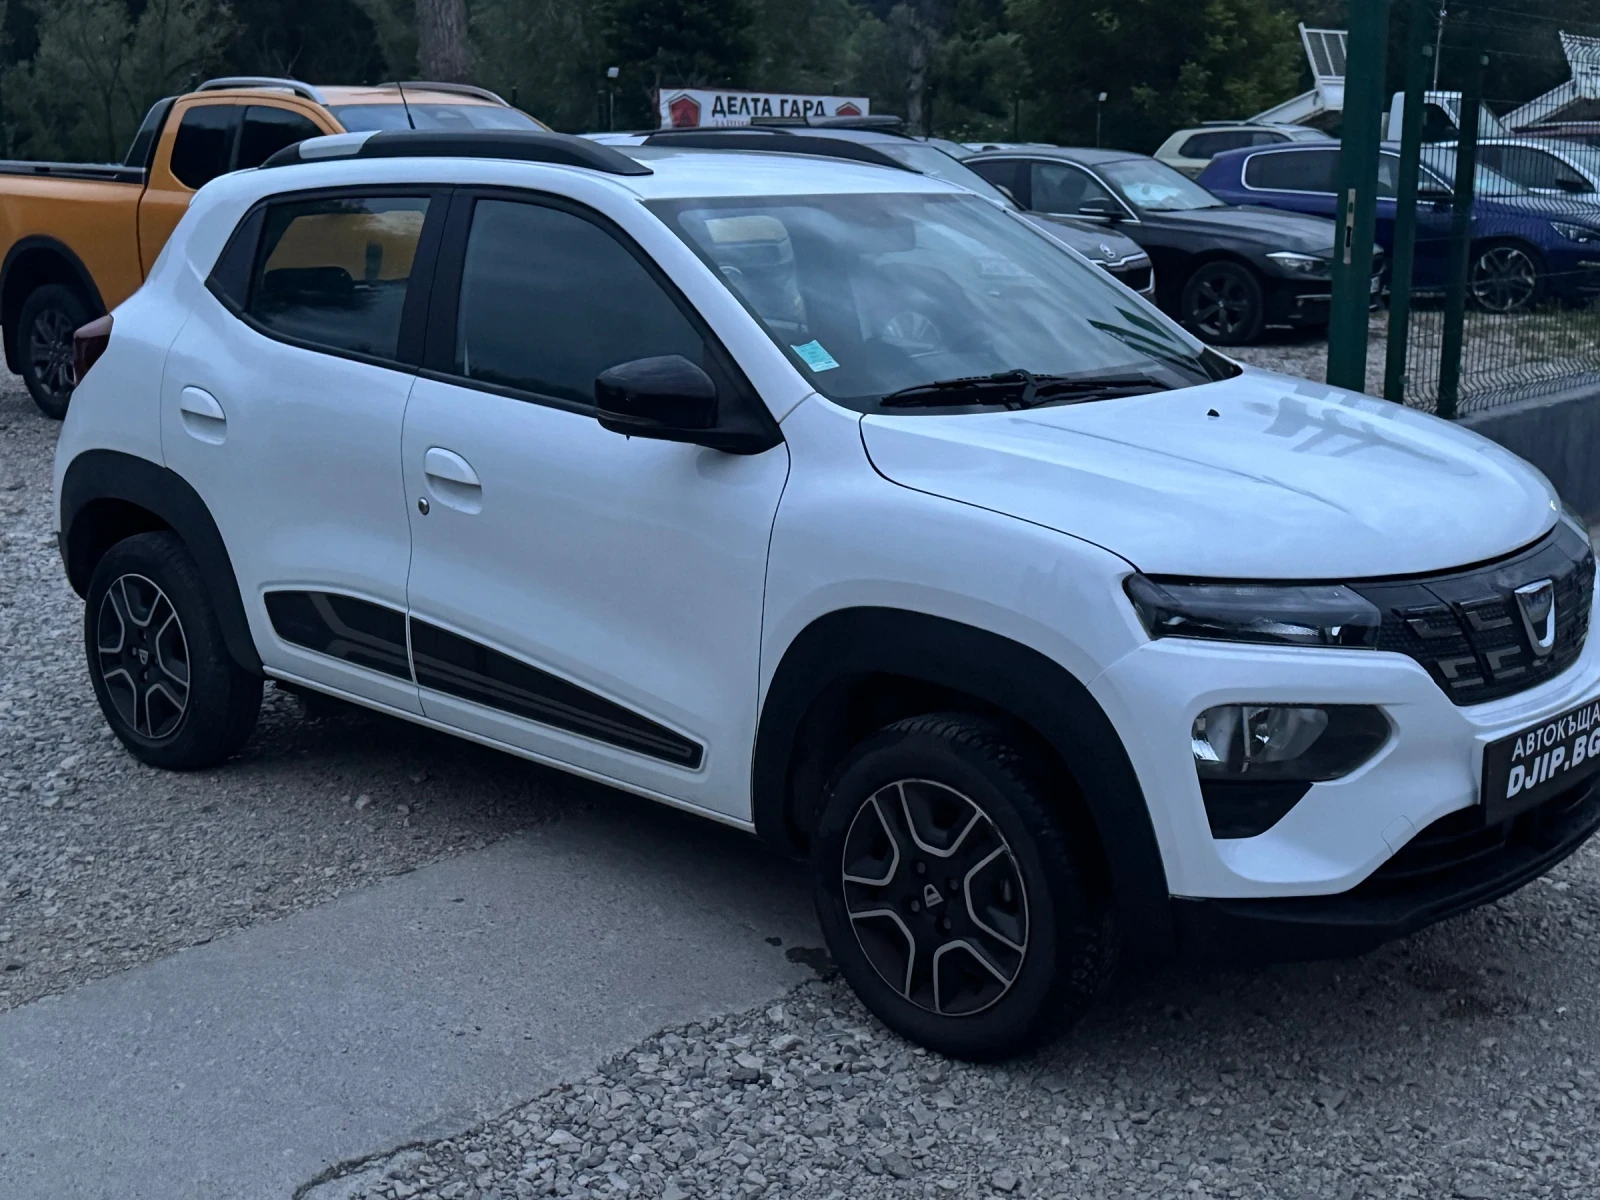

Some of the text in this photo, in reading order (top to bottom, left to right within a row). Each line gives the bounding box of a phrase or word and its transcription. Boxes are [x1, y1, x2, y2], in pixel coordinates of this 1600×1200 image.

[711, 95, 826, 117] ДЕЛТА ГАРД
[1511, 702, 1600, 761] АВТОКЪЩА
[1506, 727, 1600, 799] DJIP.BG
